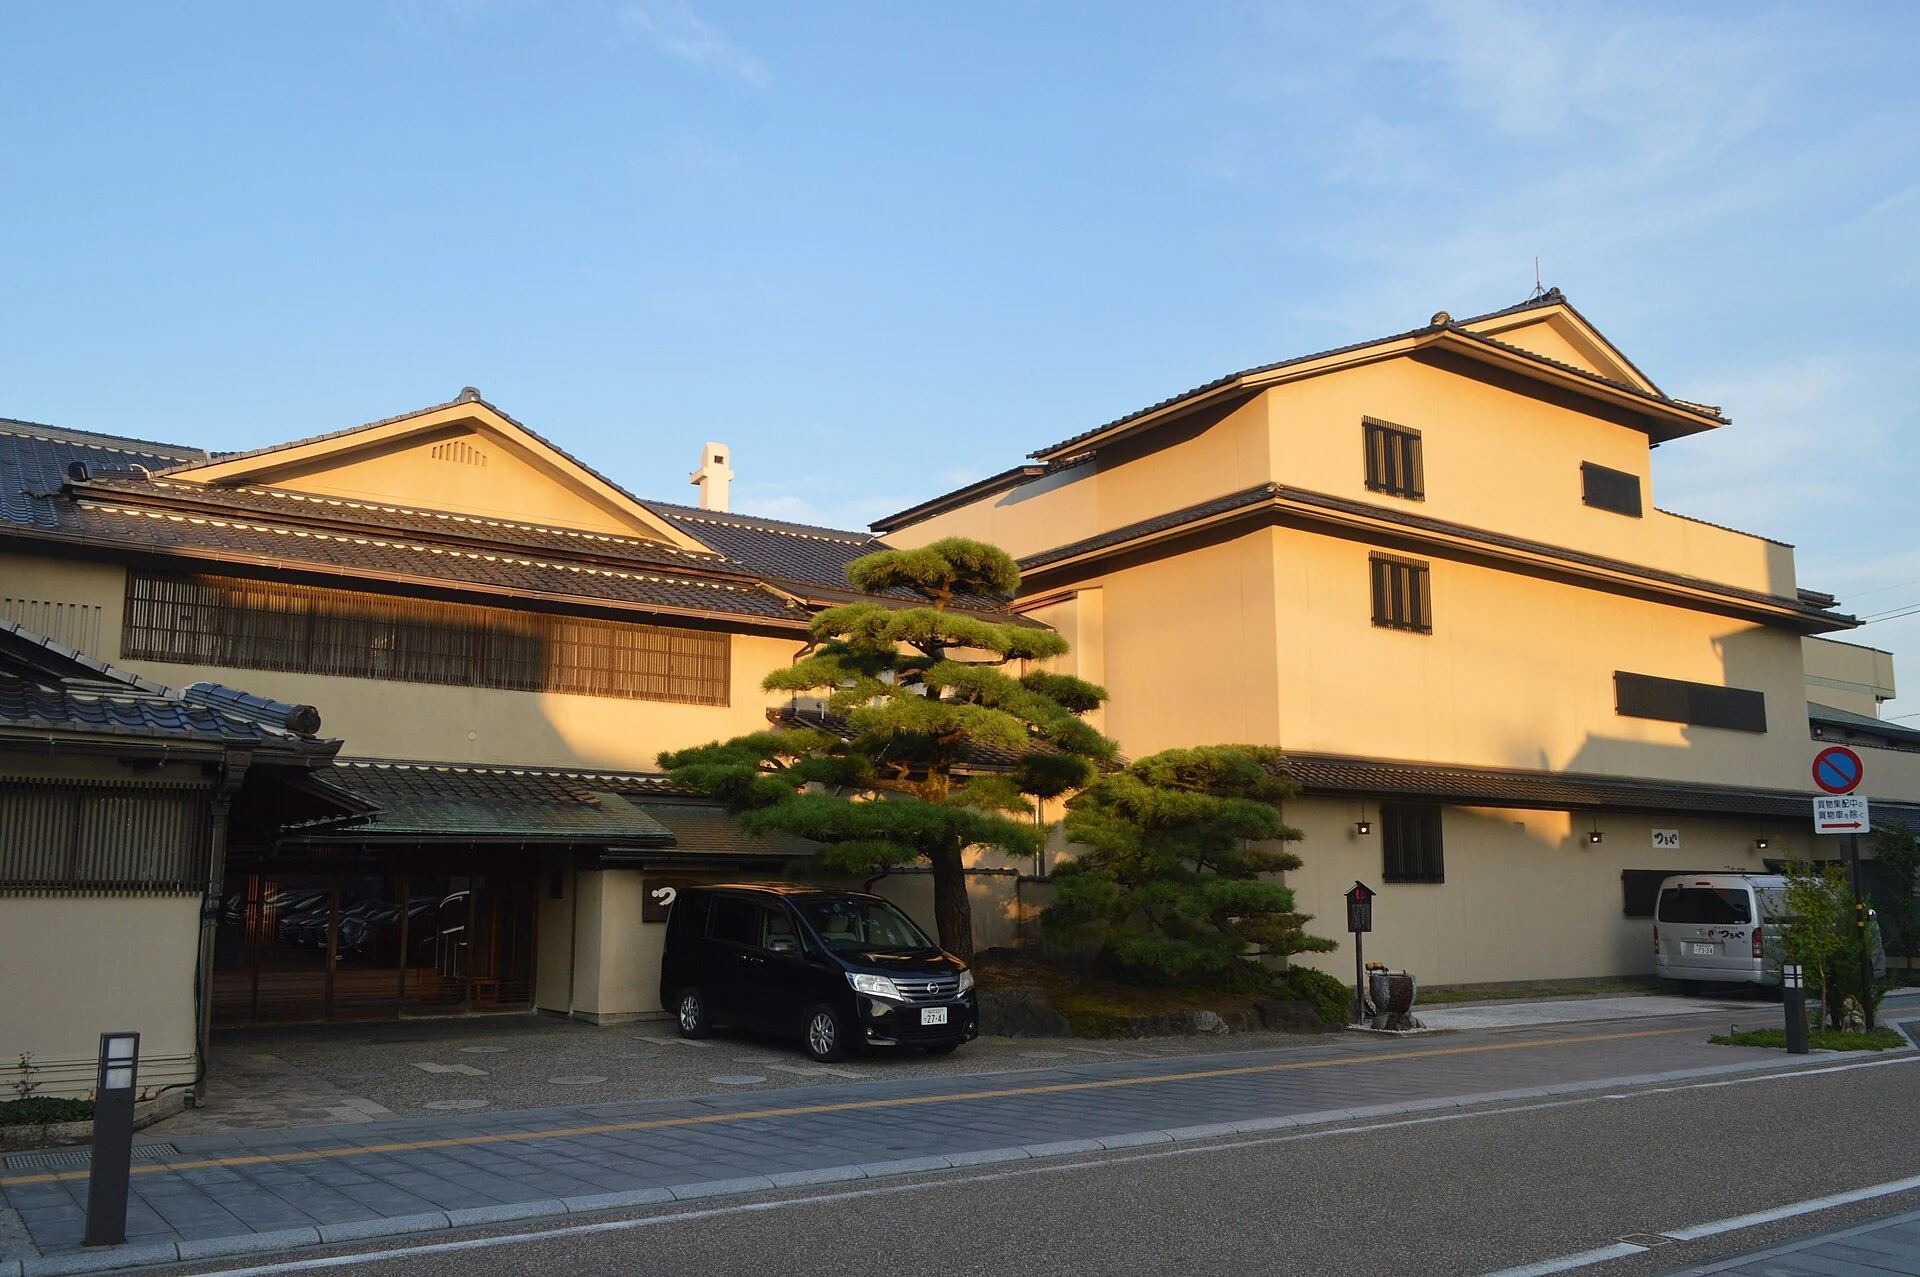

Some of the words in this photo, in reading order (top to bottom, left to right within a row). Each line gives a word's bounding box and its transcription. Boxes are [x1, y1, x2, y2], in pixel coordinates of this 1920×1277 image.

[1817, 798, 1864, 809] 貨物集配中の
[1817, 809, 1864, 820] 貨物車を除く
